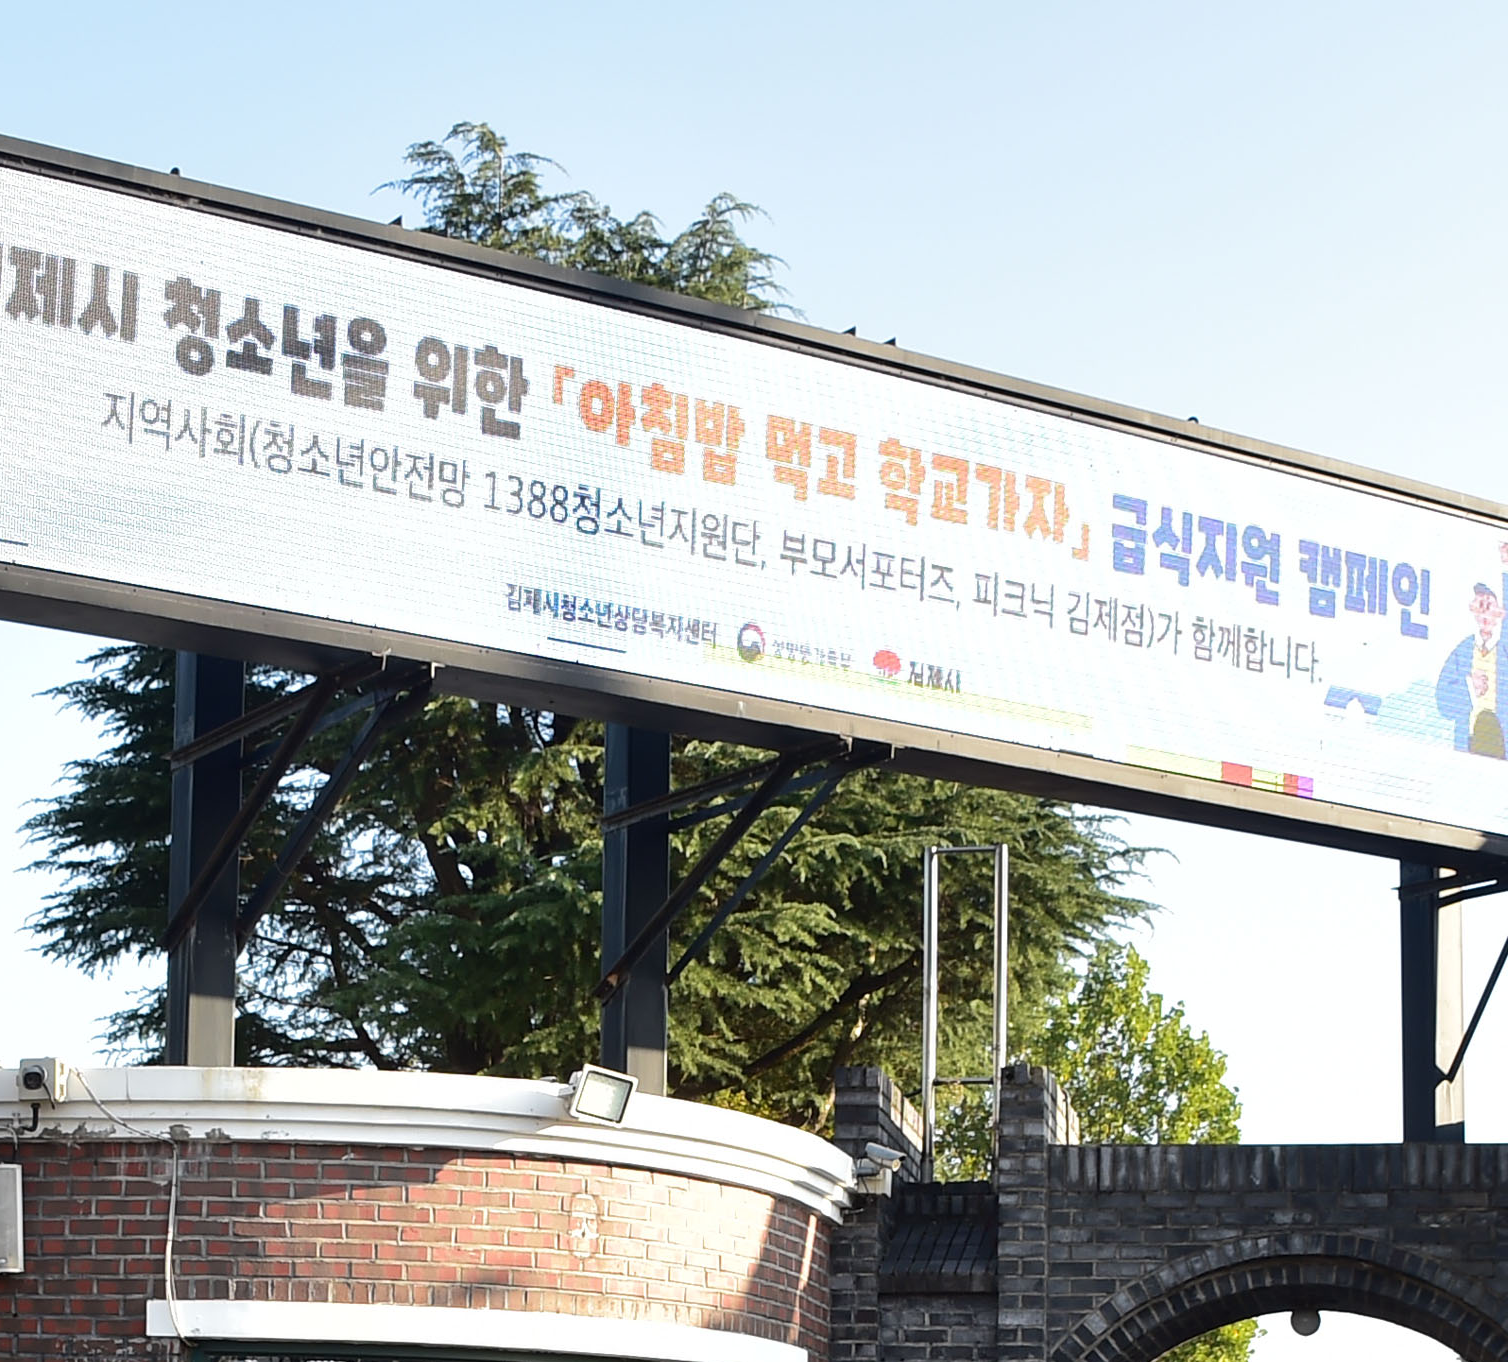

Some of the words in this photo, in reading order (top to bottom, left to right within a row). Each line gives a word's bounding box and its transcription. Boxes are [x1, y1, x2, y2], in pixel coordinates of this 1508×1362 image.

[101, 391, 471, 509] 지역사회(청소년안전망
[483, 471, 767, 570] 1388청소년지원단,
[780, 529, 960, 611] 부모서포터즈,
[973, 572, 1054, 628] 피크닉
[1067, 592, 1182, 655] 김제점)가
[1192, 616, 1322, 683] 함께합니다.
[163, 276, 389, 411] 청소년을
[413, 336, 529, 441] 위한
[552, 365, 745, 486] 「아침밥
[766, 414, 857, 501] 먹고
[878, 437, 1090, 561] 학교가자」
[1112, 493, 1281, 607] 급식지원
[1299, 538, 1431, 640] 캠페인
